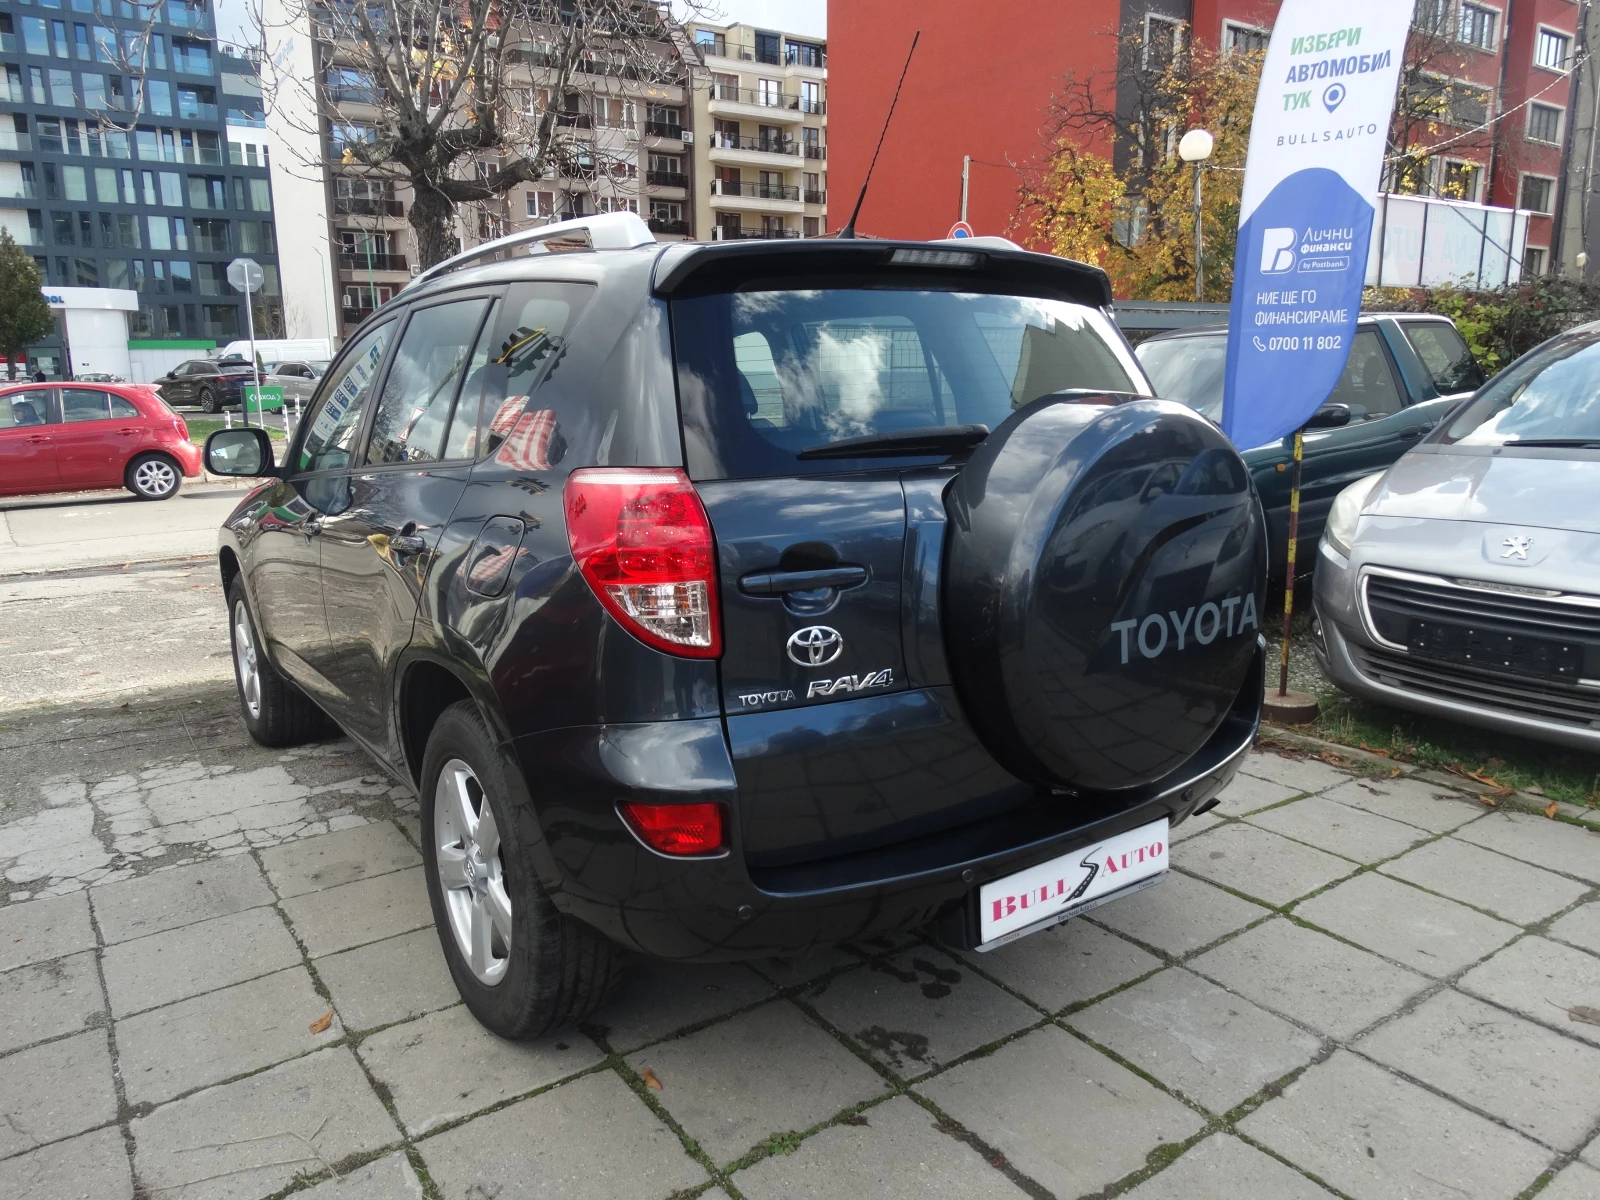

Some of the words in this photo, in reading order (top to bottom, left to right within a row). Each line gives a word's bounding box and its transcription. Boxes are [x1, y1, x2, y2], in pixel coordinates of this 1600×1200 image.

[1290, 27, 1363, 56] ИЗБЕРИ
[1285, 49, 1391, 84] АВТОМОБИЛ
[1282, 90, 1312, 111] ТУК
[1276, 123, 1377, 147] BULLSAUTO
[1301, 227, 1353, 243] Лични
[1303, 262, 1311, 270] by
[1312, 260, 1344, 268] Postbank
[1256, 291, 1280, 305] НИЕ
[1281, 290, 1299, 305] ЩЕ
[1301, 290, 1317, 304] ГО
[1254, 308, 1348, 326] ФИНАНСИРАМЕ
[1269, 336, 1299, 351] 0700
[1302, 336, 1313, 350] 11
[1316, 335, 1341, 350] 802
[1110, 592, 1259, 665] TOYOTA
[738, 689, 796, 707] TOYOTA
[806, 668, 894, 699] RAV4
[1002, 932, 1020, 943] TOYOTA
